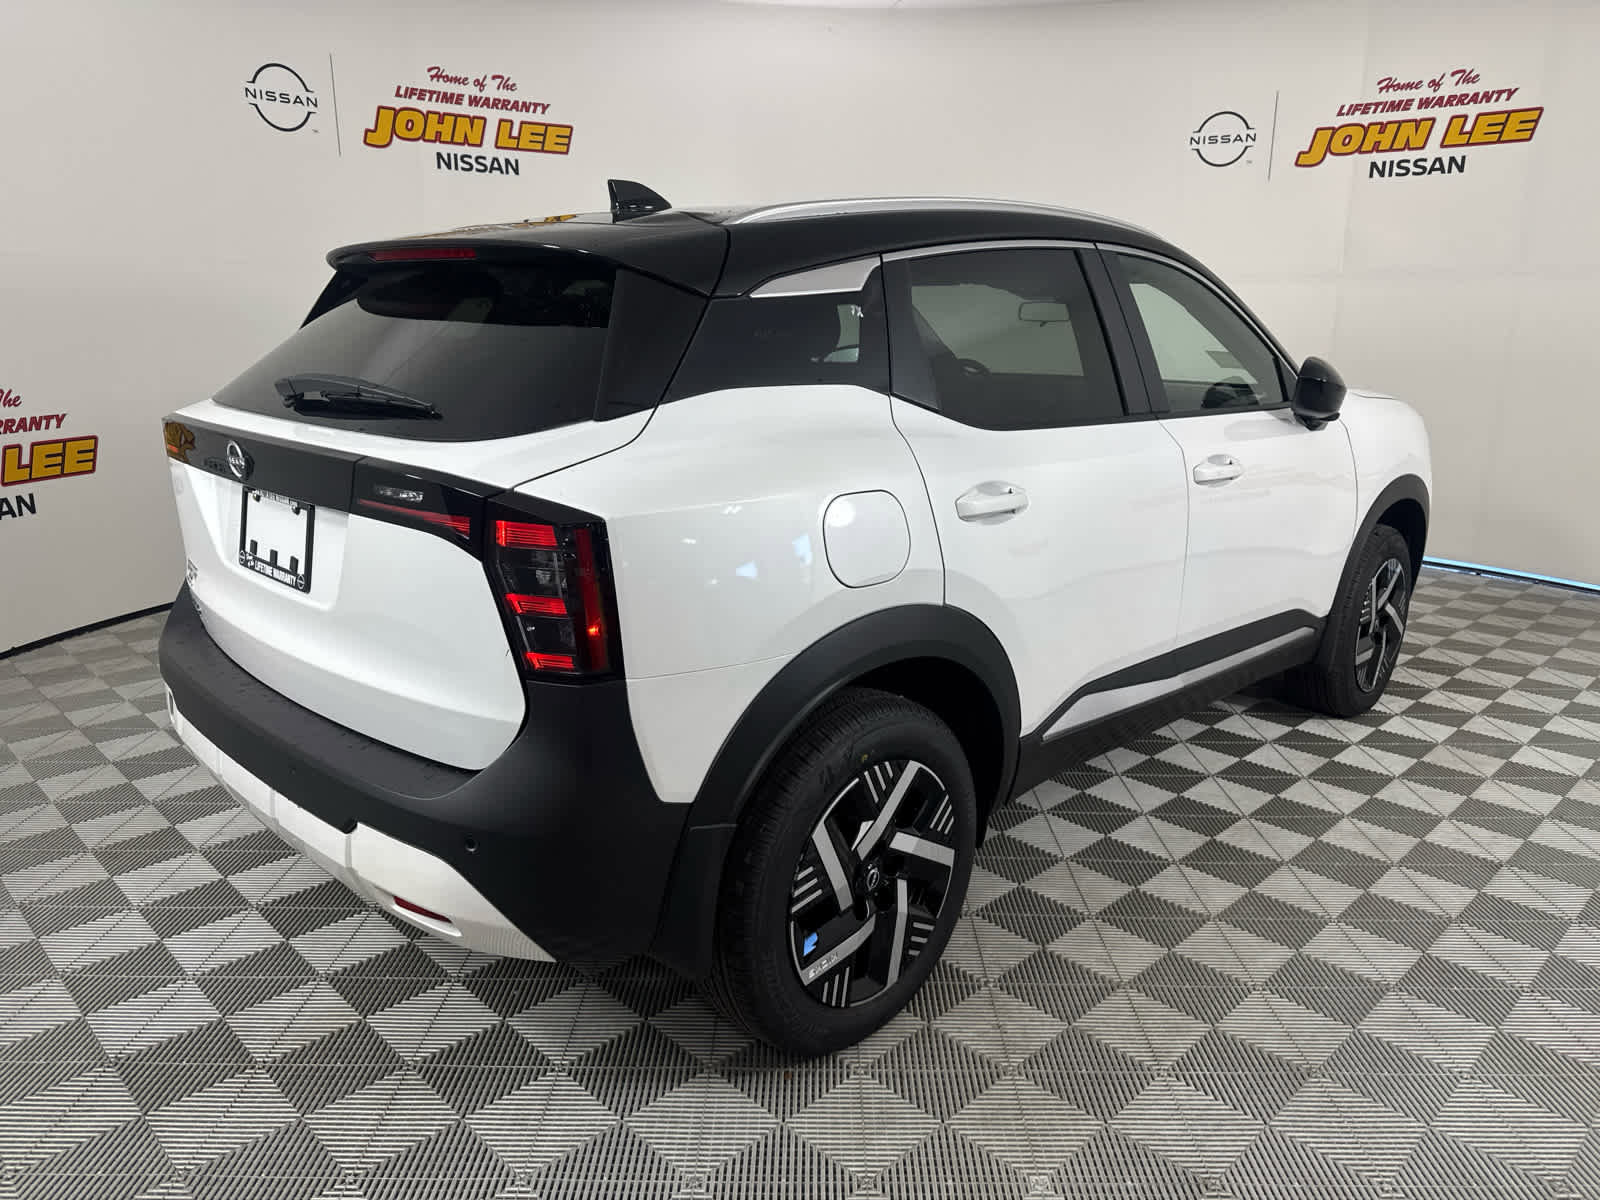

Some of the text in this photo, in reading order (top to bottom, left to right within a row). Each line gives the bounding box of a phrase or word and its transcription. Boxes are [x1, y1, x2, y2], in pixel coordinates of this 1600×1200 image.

[427, 66, 518, 92] Home of The
[1377, 69, 1481, 94] Home of The
[244, 87, 319, 108] NISSAN
[394, 85, 551, 116] LIFETIME WARRANTY
[1336, 87, 1519, 117] LIFETIME WARRANTY
[363, 105, 574, 155] JOHN LEE
[1189, 132, 1257, 147] NISSAN
[1294, 106, 1544, 168] JOHN LEE
[436, 151, 520, 176] NISSAN
[1368, 155, 1467, 179] NISSAN
[0, 413, 67, 434] RANTY
[1, 435, 98, 487] LEE
